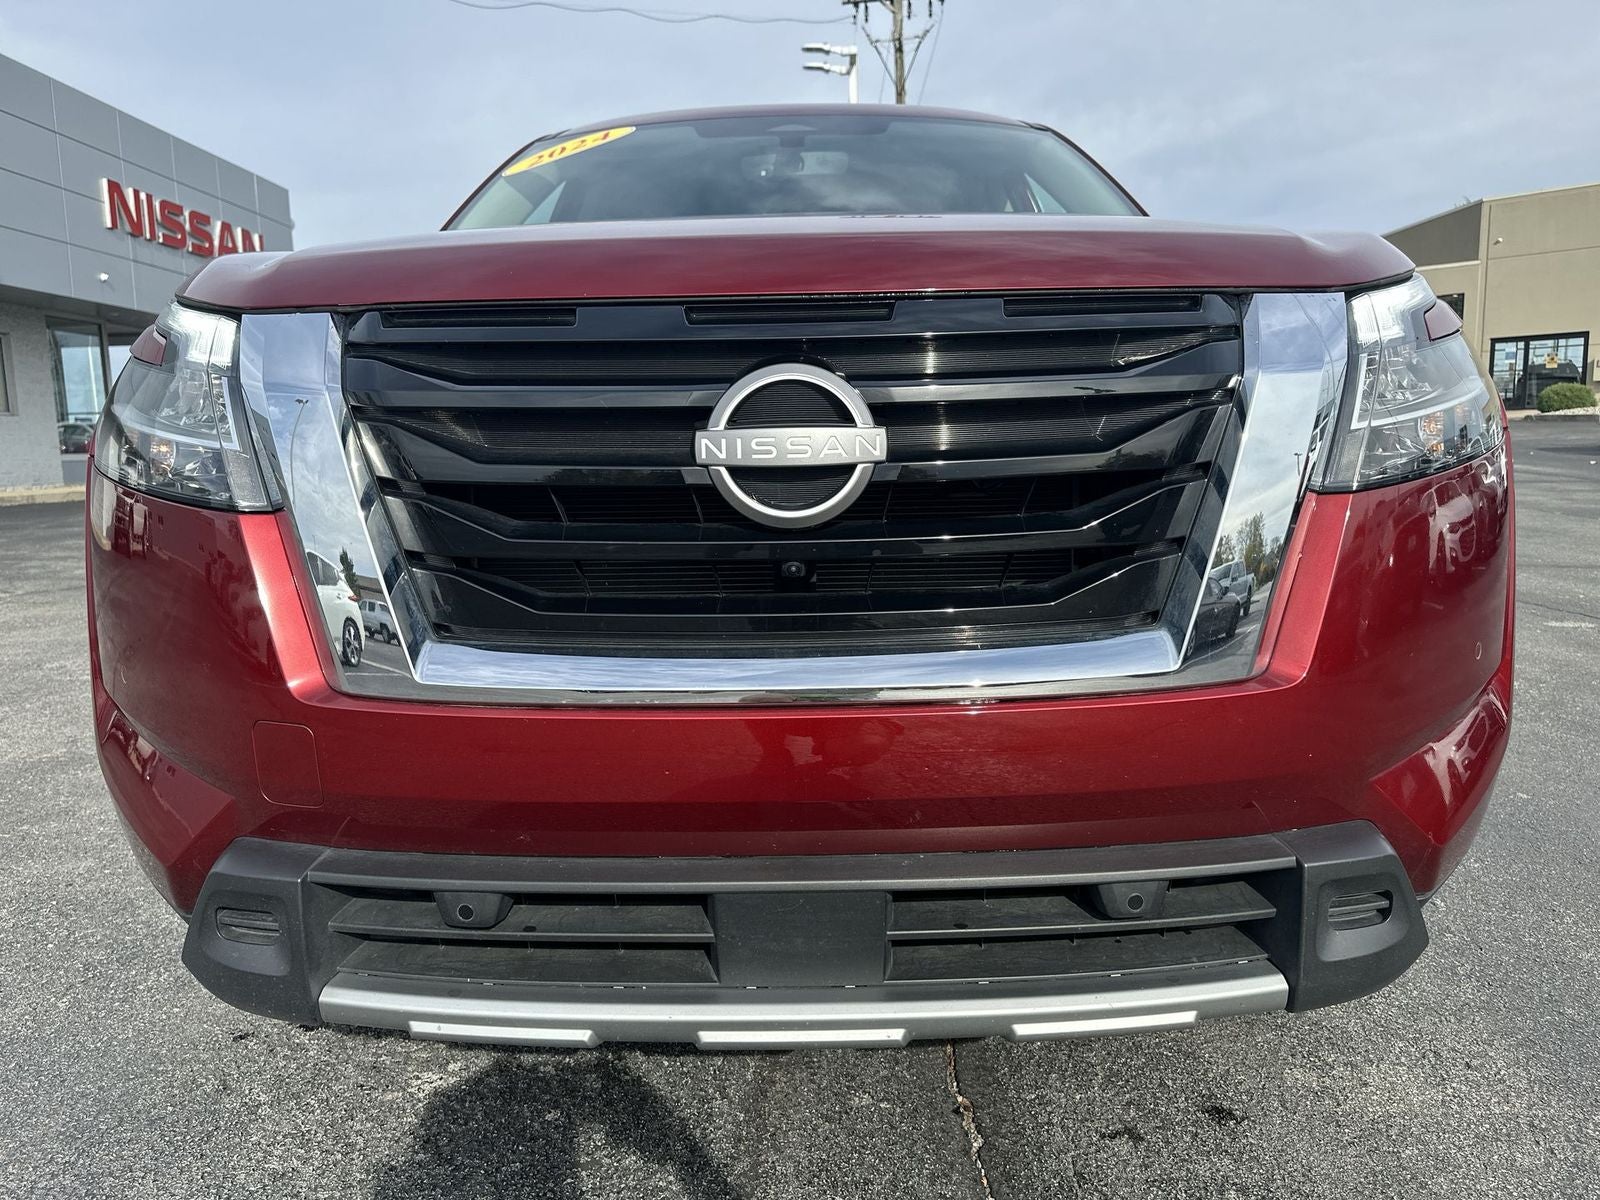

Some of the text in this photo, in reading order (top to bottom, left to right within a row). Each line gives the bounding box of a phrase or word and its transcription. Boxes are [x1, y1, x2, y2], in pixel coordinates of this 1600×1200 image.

[527, 131, 611, 168] 2024
[102, 177, 265, 257] NISSAN
[700, 433, 881, 459] NISSAN
